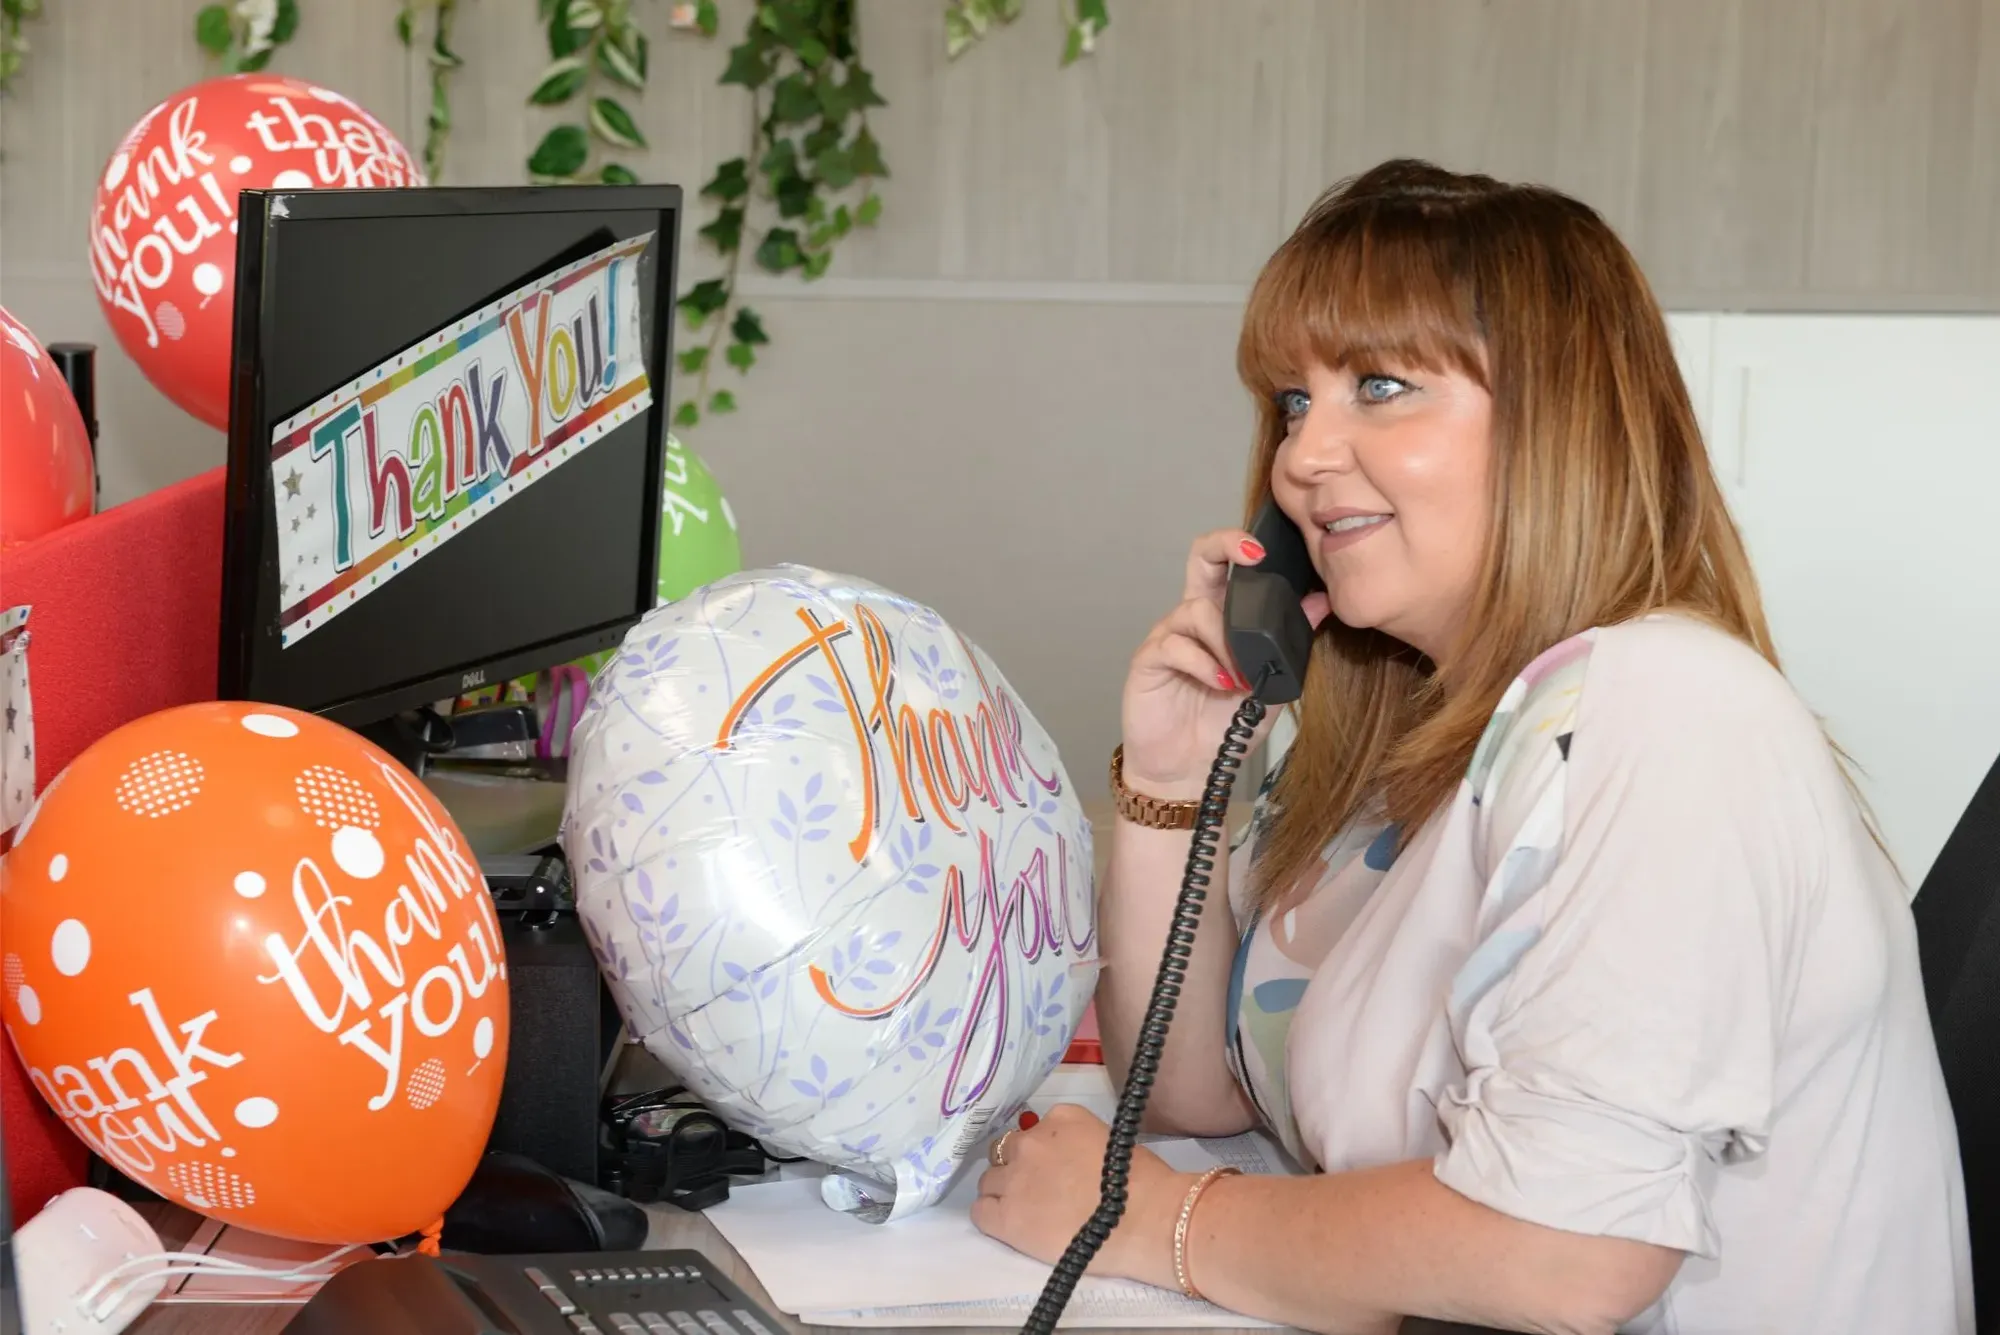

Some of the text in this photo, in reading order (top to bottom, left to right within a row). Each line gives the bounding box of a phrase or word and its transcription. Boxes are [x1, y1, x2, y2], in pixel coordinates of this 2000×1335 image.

[114, 172, 239, 348] you!
[311, 258, 623, 571] Thank You!
[462, 670, 486, 688] DELL
[257, 751, 475, 1033] thank
[340, 892, 506, 1110] you!
[809, 828, 1095, 1118] you
